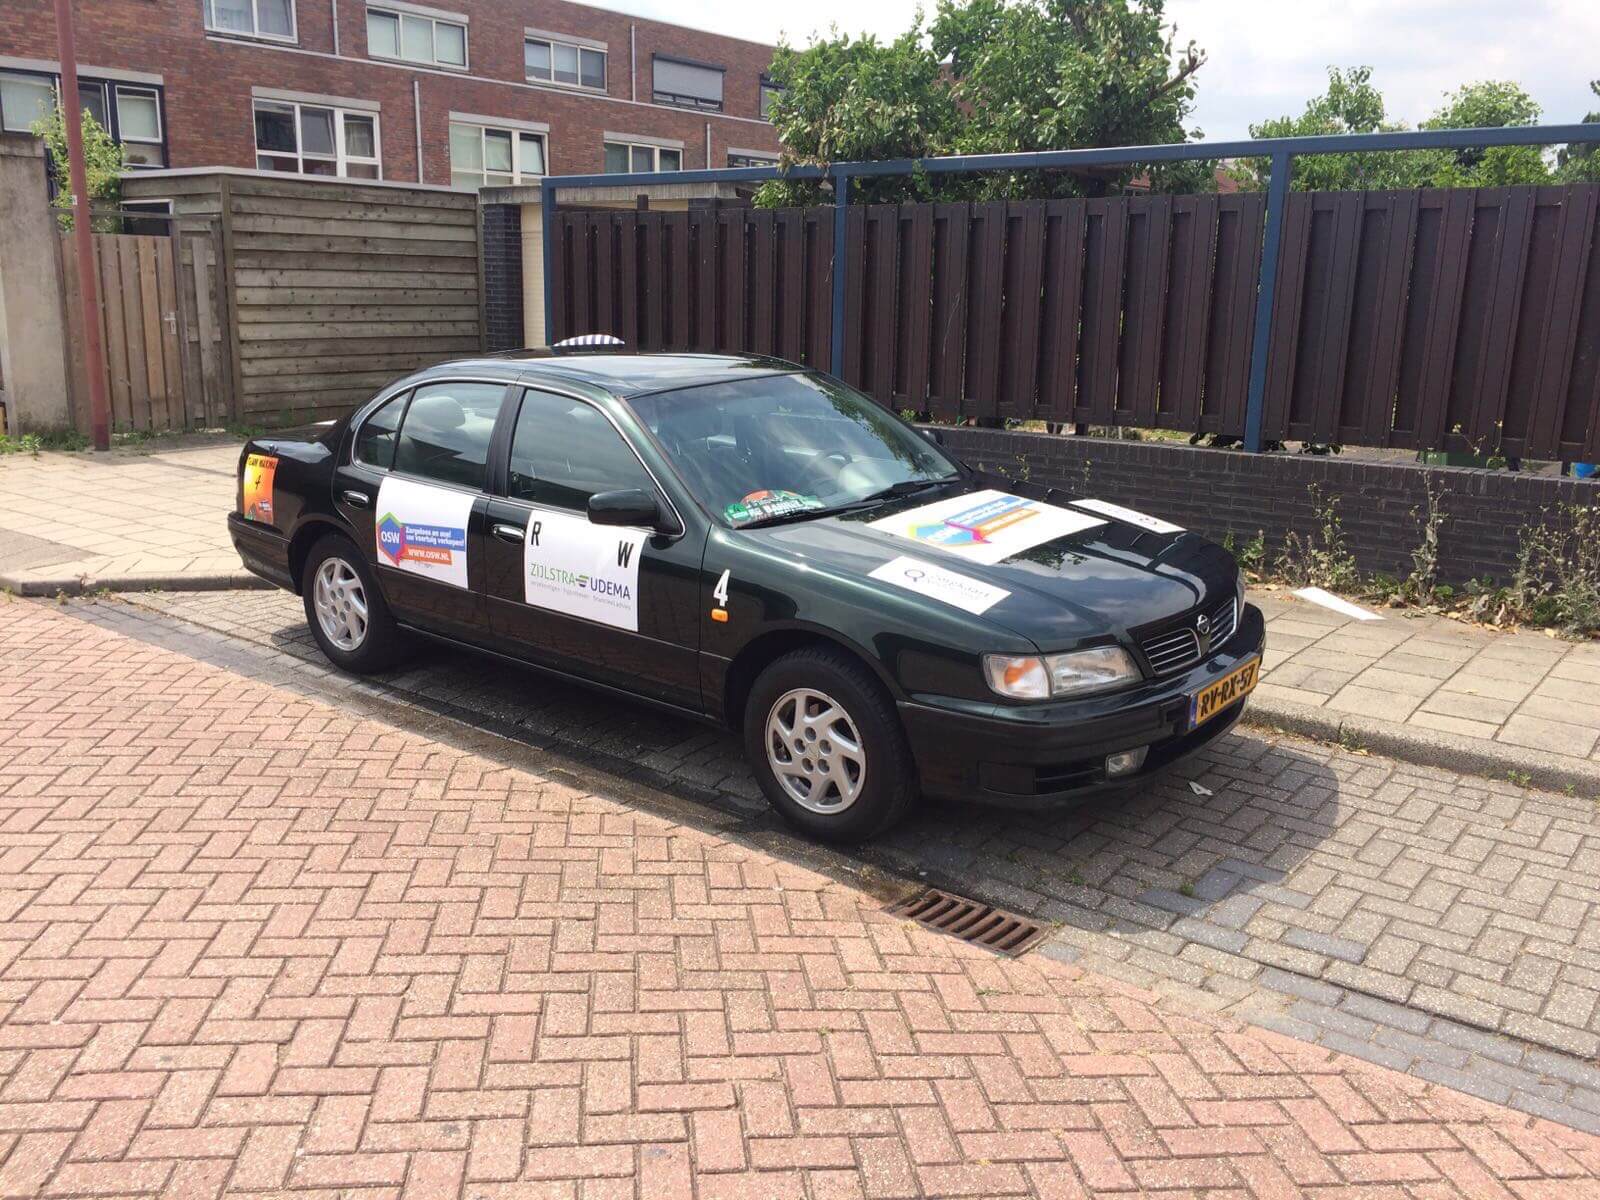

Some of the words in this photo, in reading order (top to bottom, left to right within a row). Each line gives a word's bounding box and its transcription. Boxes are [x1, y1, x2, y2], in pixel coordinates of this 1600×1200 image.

[381, 530, 400, 543] OSW
[531, 521, 542, 546] R
[618, 540, 634, 568] W
[591, 577, 631, 600] UDEMA
[713, 569, 730, 607] 4
[1201, 663, 1256, 717] RV-RX-57
